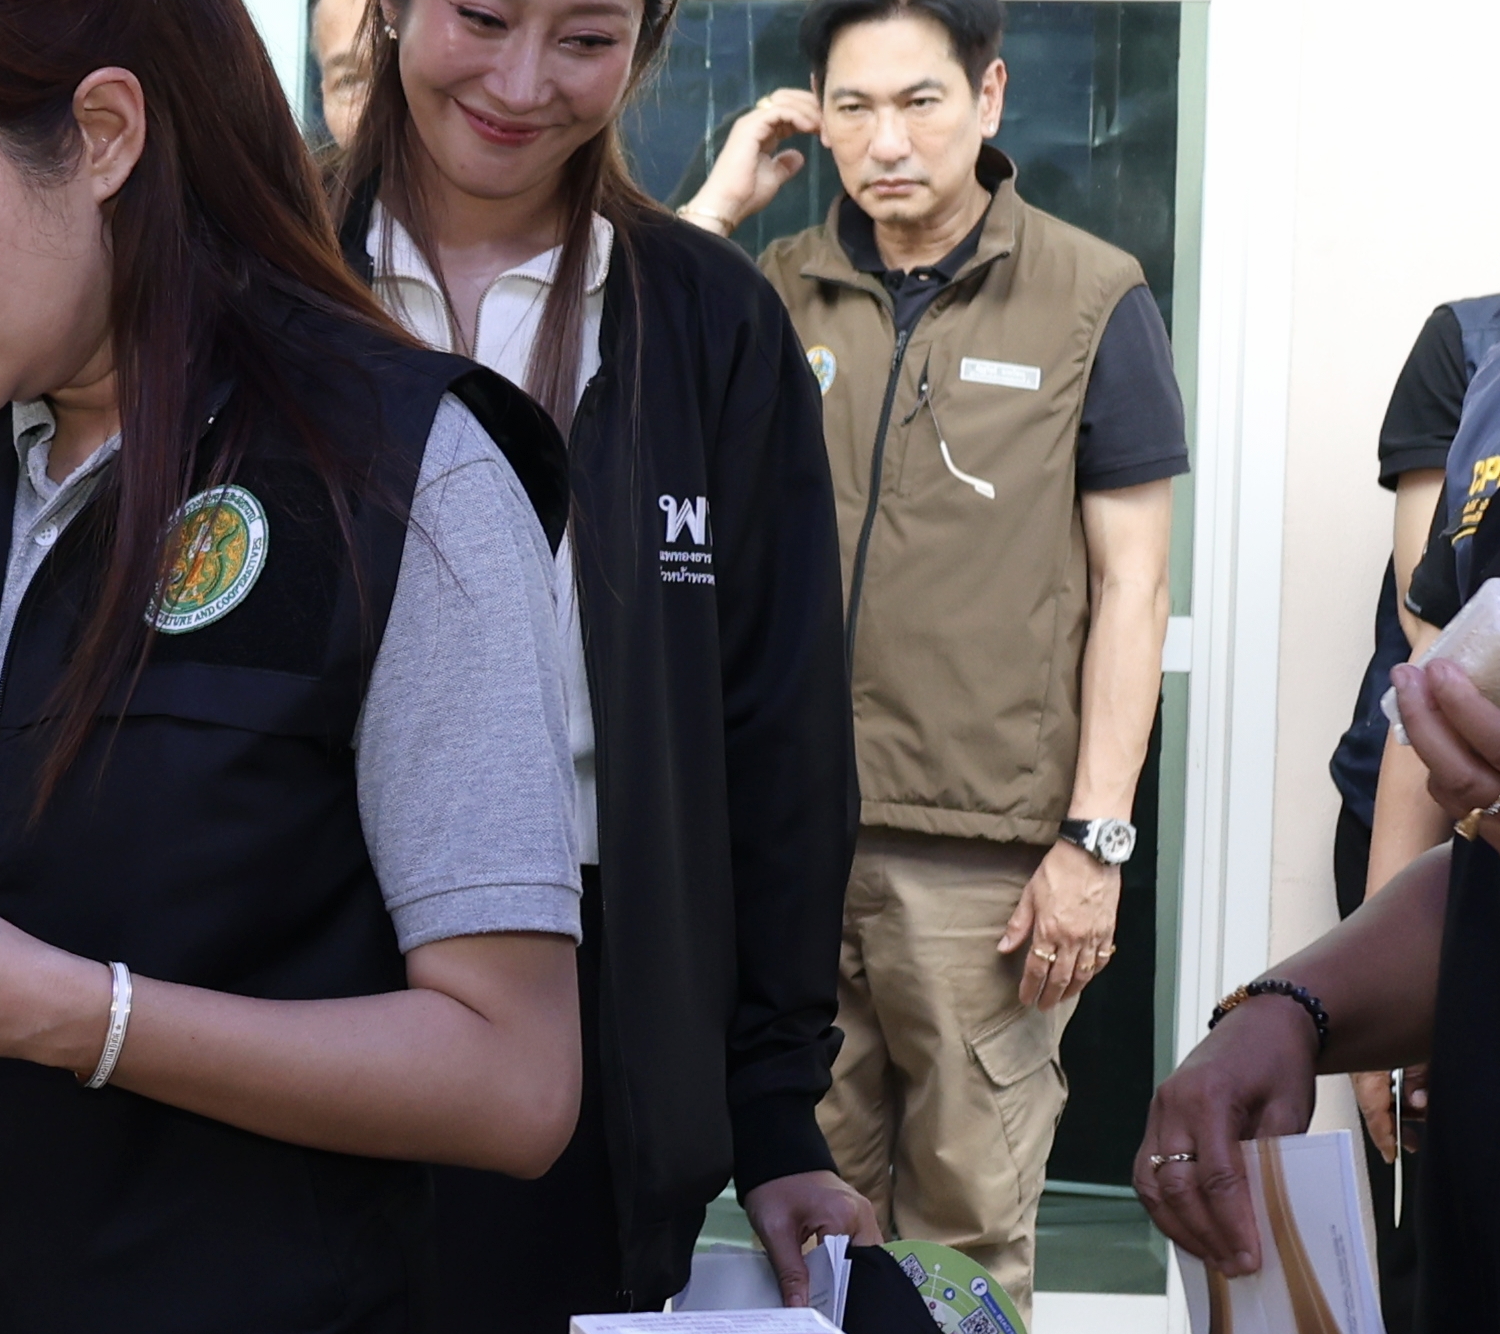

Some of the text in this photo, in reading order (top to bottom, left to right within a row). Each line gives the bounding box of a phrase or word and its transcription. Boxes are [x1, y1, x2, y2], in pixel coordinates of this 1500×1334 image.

[195, 598, 216, 621] AND
[216, 537, 263, 610] COOPERATIVES
[659, 550, 712, 564] แพทองธาร
